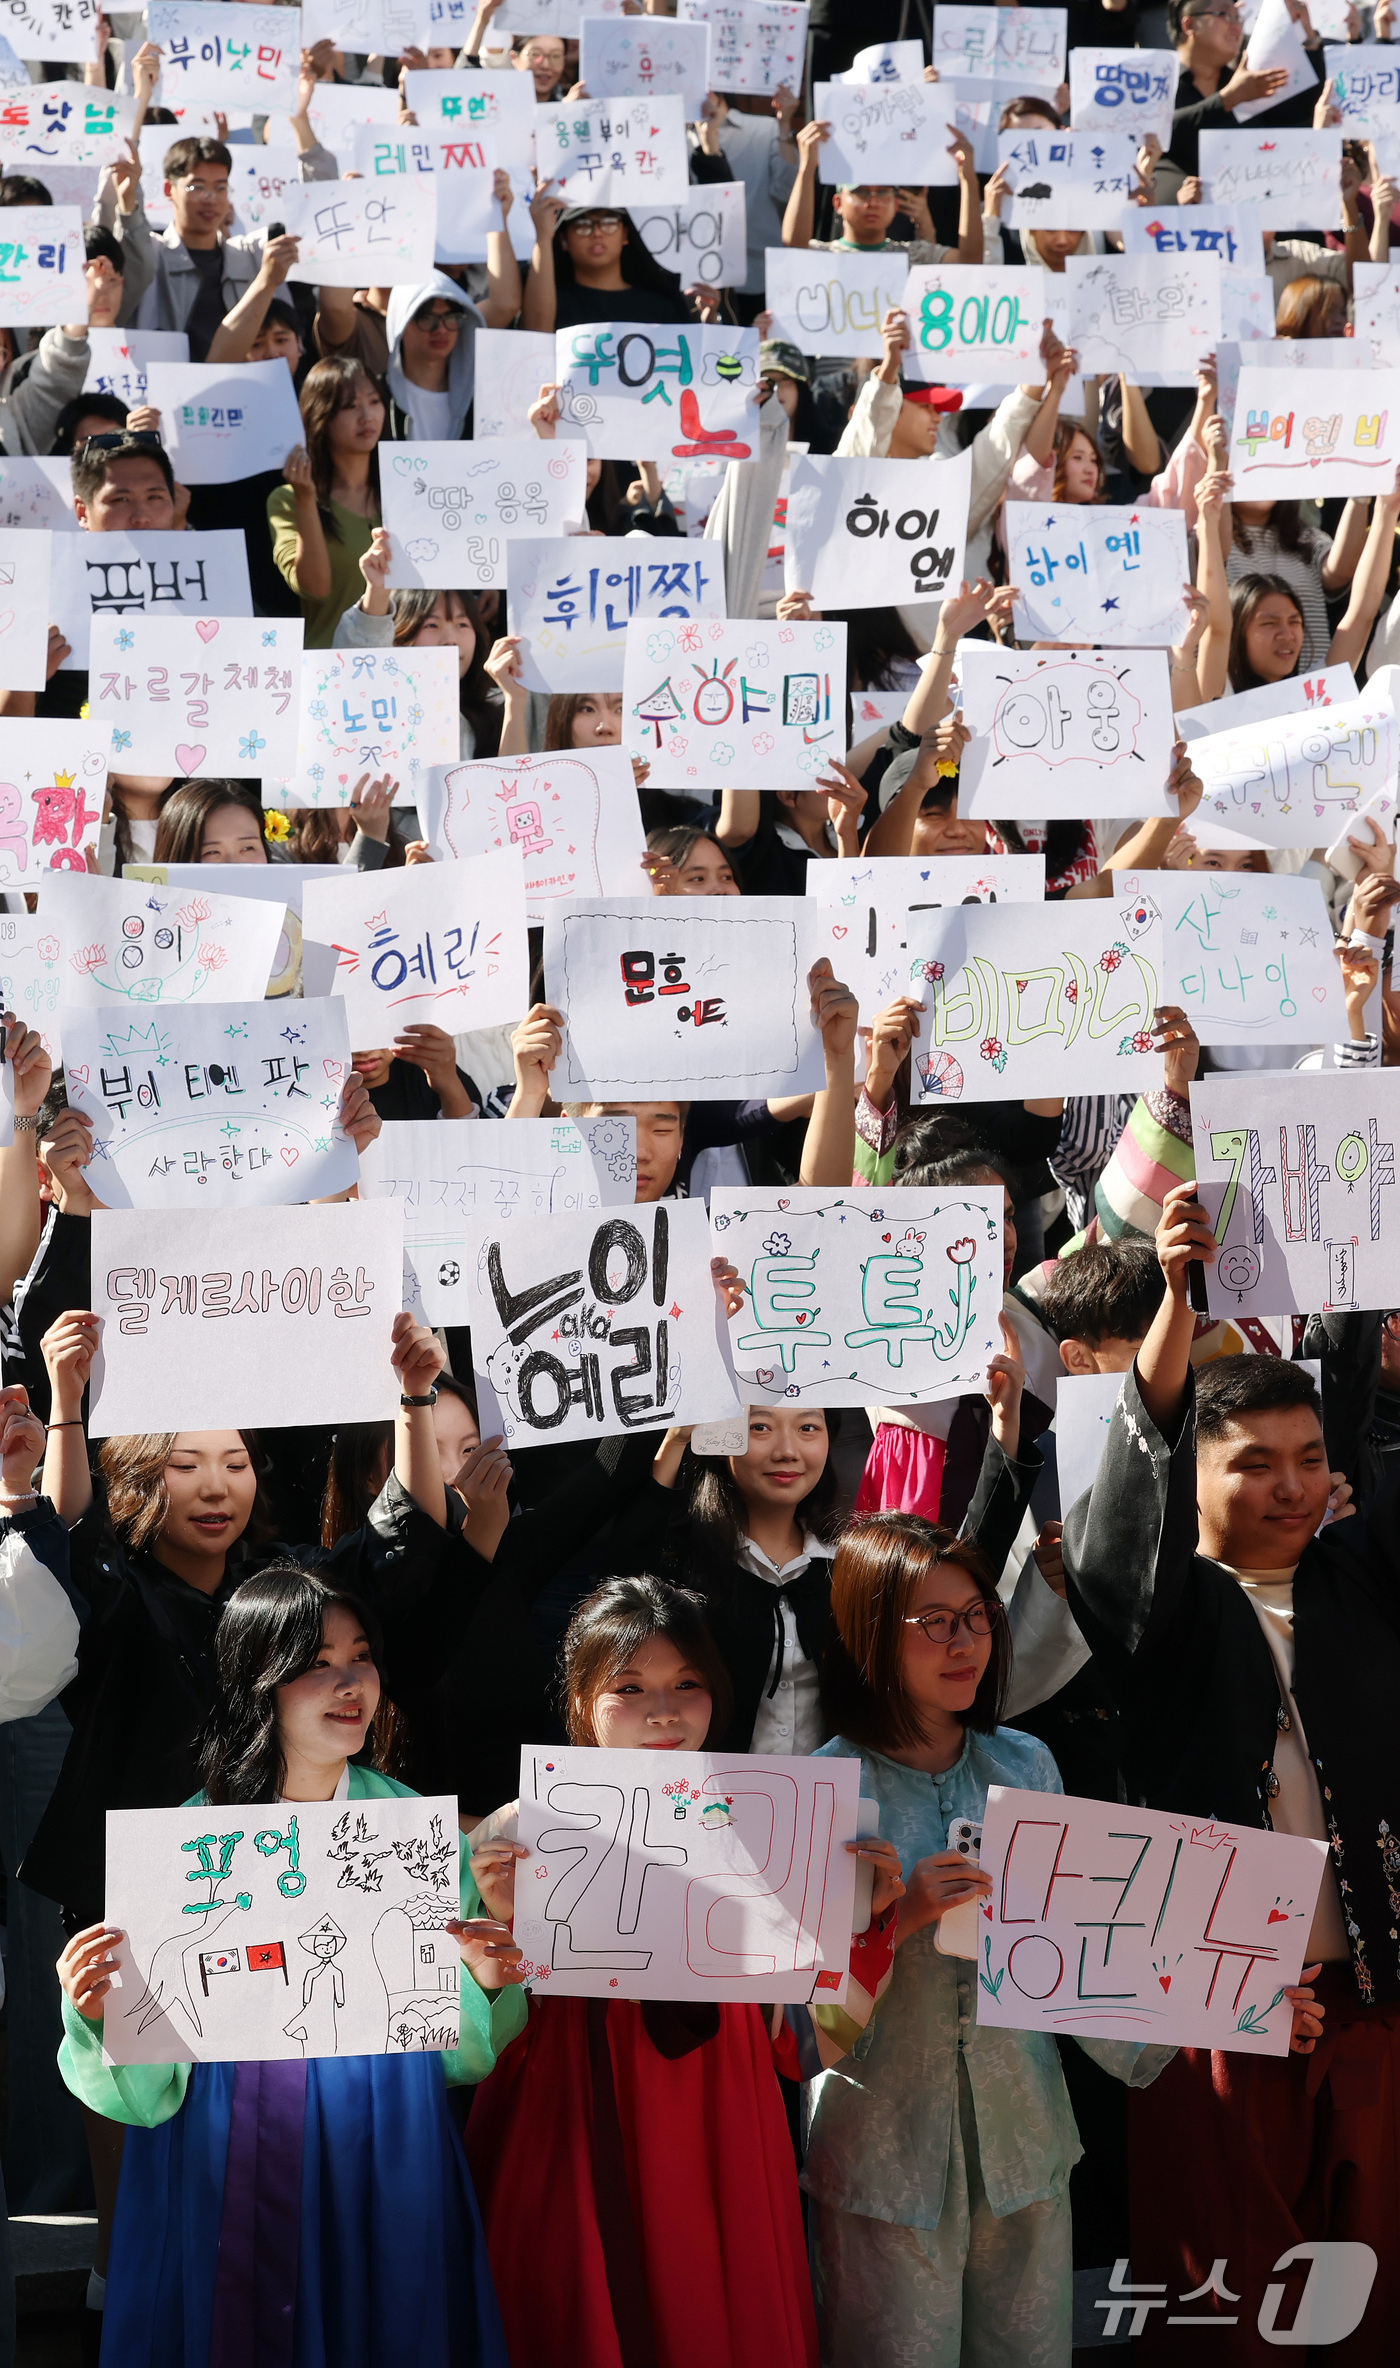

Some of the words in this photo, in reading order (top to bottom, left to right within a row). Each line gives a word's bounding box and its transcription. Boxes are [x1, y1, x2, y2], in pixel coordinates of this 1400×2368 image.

[169, 36, 281, 81] 부이낫민
[600, 118, 630, 142] 부이
[374, 142, 486, 175] 레민찌
[314, 201, 396, 250] 뚜안
[1109, 285, 1186, 326] 타오
[846, 493, 940, 541] 하이
[100, 663, 292, 728] 자르갈체첵
[343, 696, 397, 733] 노민
[1175, 893, 1225, 951] 산
[368, 921, 480, 991] 혜린
[620, 951, 691, 1007] 문흐
[934, 952, 1159, 1050] 비마니
[100, 1066, 162, 1119] 부이
[184, 1063, 245, 1099] 티엔
[262, 1056, 310, 1099] 팟
[148, 1145, 273, 1184] 사랑한다
[107, 1266, 375, 1335] 델게르사이한
[519, 1319, 676, 1430] 예린
[537, 1770, 834, 1977] 칸리
